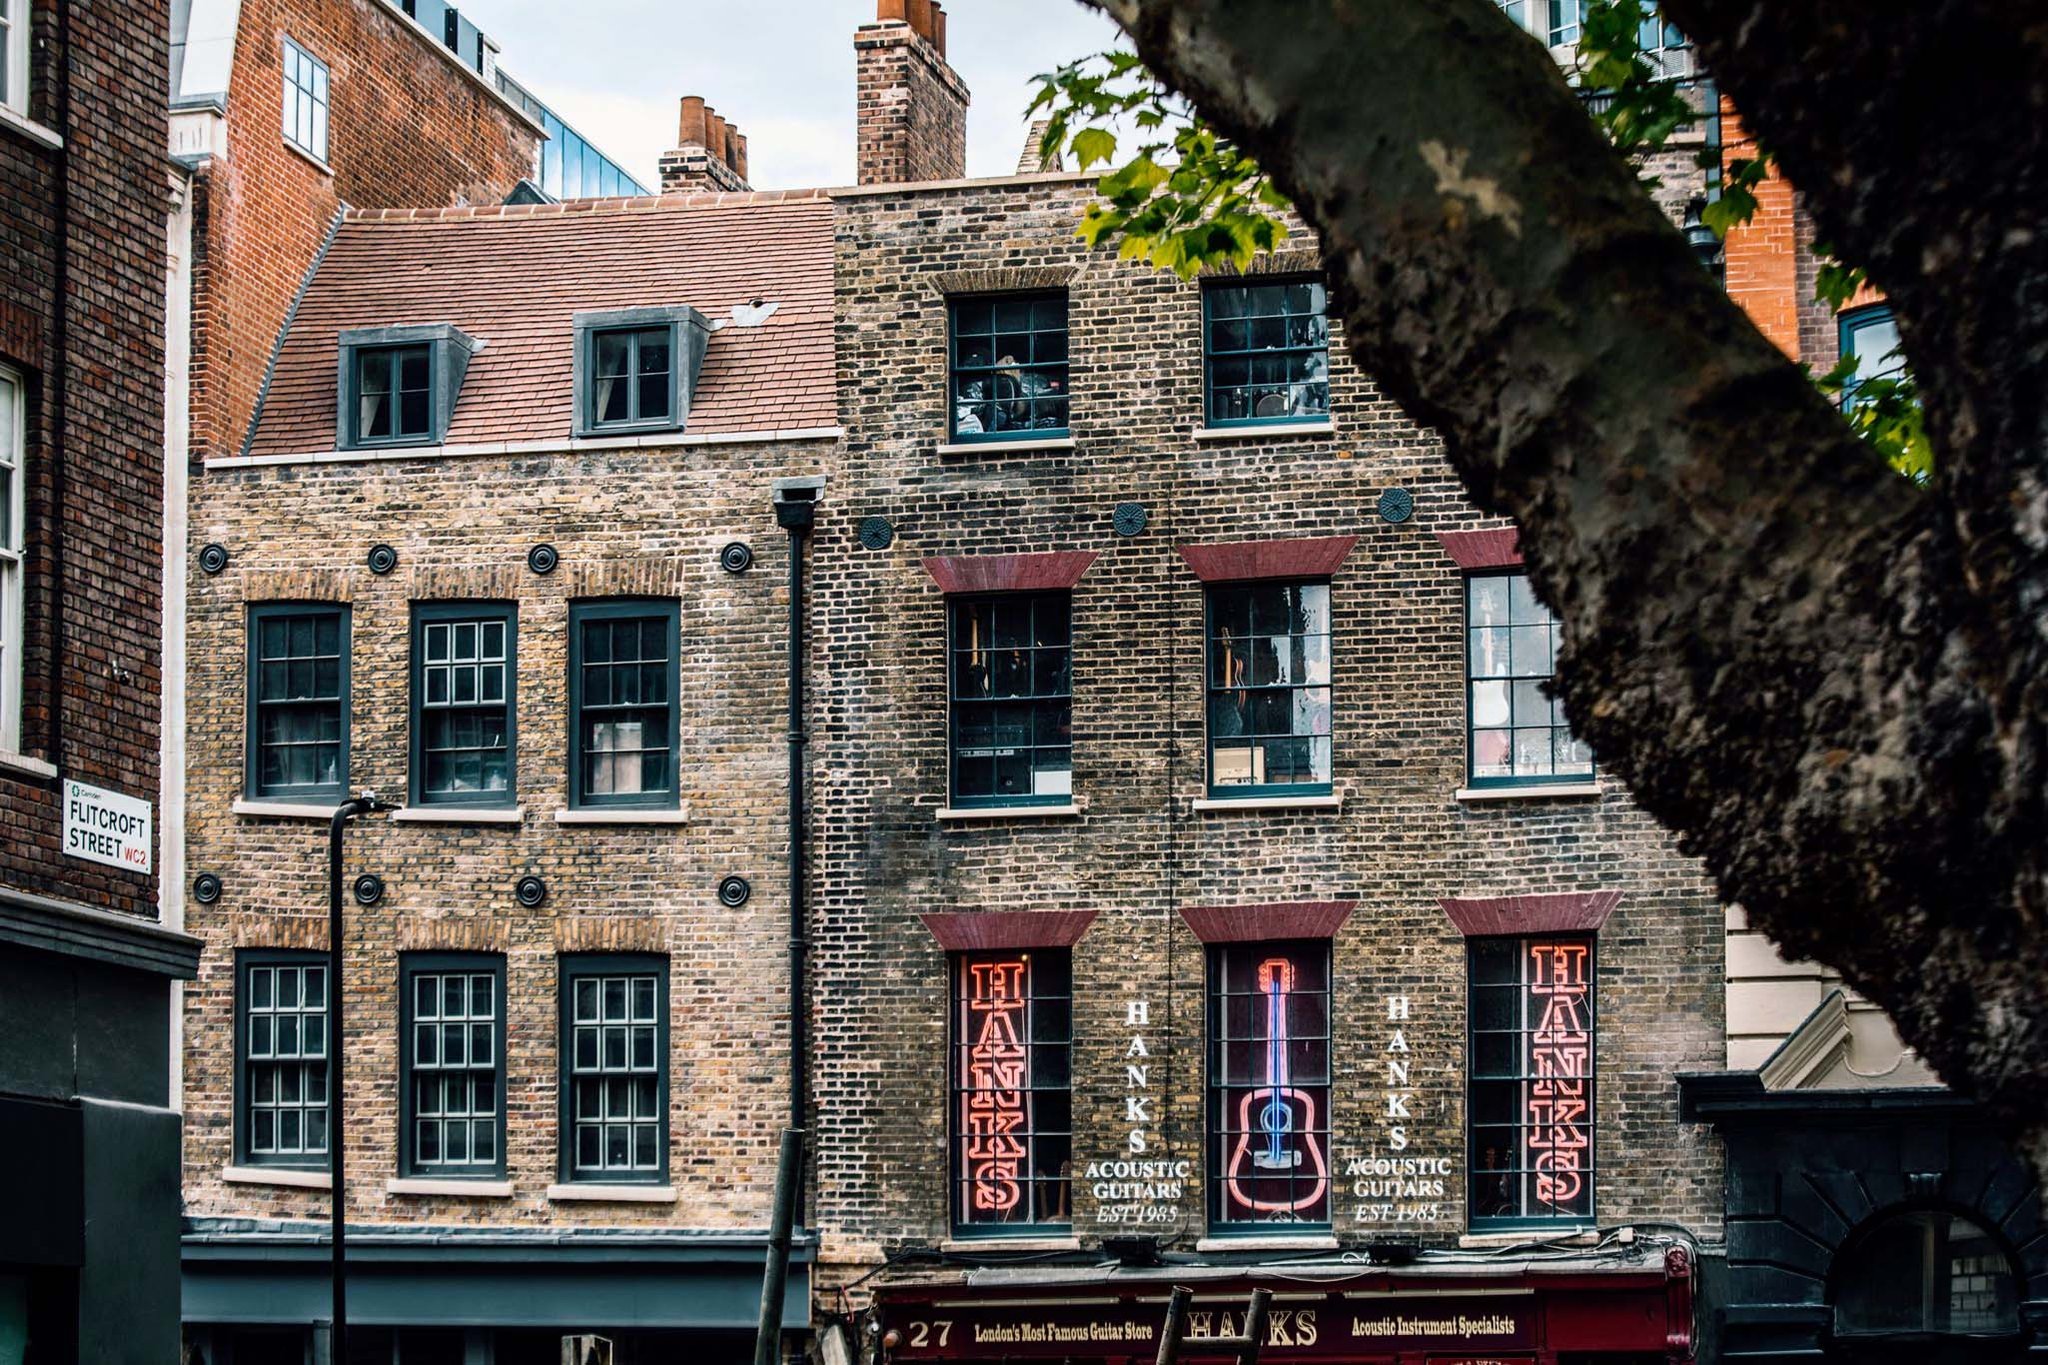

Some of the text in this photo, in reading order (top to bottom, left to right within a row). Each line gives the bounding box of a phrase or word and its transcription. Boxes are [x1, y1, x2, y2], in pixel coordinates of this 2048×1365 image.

[71, 800, 145, 838] FLITCROFT
[70, 827, 146, 866] STREET WC2
[969, 962, 1026, 1209] HANKS
[1126, 1001, 1150, 1153] HANKS
[1387, 996, 1411, 1150] HANKS
[1529, 946, 1588, 1201] HANKS
[1085, 1161, 1189, 1179] ACOUSTIC
[1345, 1158, 1452, 1176] ACOUSTIC
[1093, 1182, 1182, 1200] GUITARS
[1354, 1180, 1444, 1198] GUITARS
[1136, 1205, 1179, 1223] 1985
[1398, 1202, 1438, 1221] 1985
[909, 1320, 954, 1348] 27
[974, 1320, 1153, 1343] London's Most Famous Guitar Store
[1188, 1310, 1318, 1347] HAKS
[1352, 1314, 1515, 1339] Acoustic Instrument Specialists
